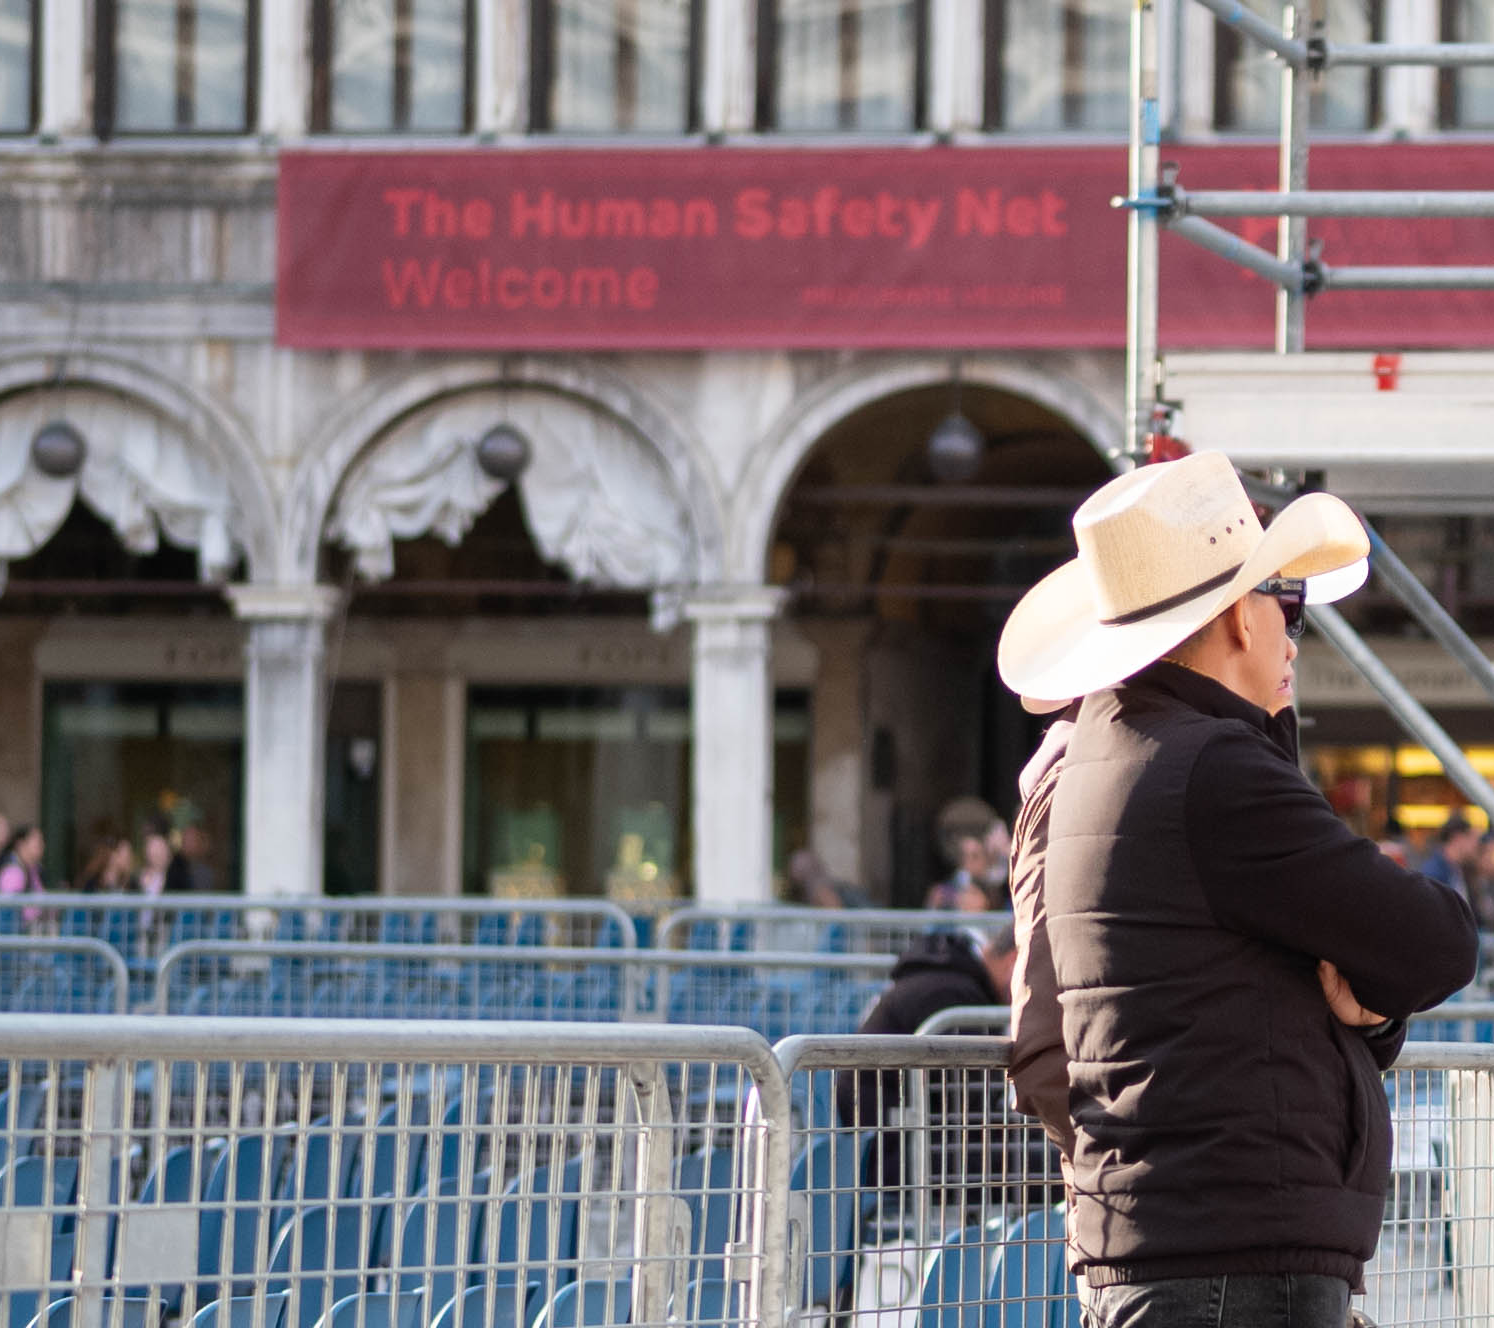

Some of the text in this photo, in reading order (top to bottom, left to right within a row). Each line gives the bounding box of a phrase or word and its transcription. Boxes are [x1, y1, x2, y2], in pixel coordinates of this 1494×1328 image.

[383, 185, 1068, 250] The Human Safety Net
[382, 258, 660, 309] Welcome
